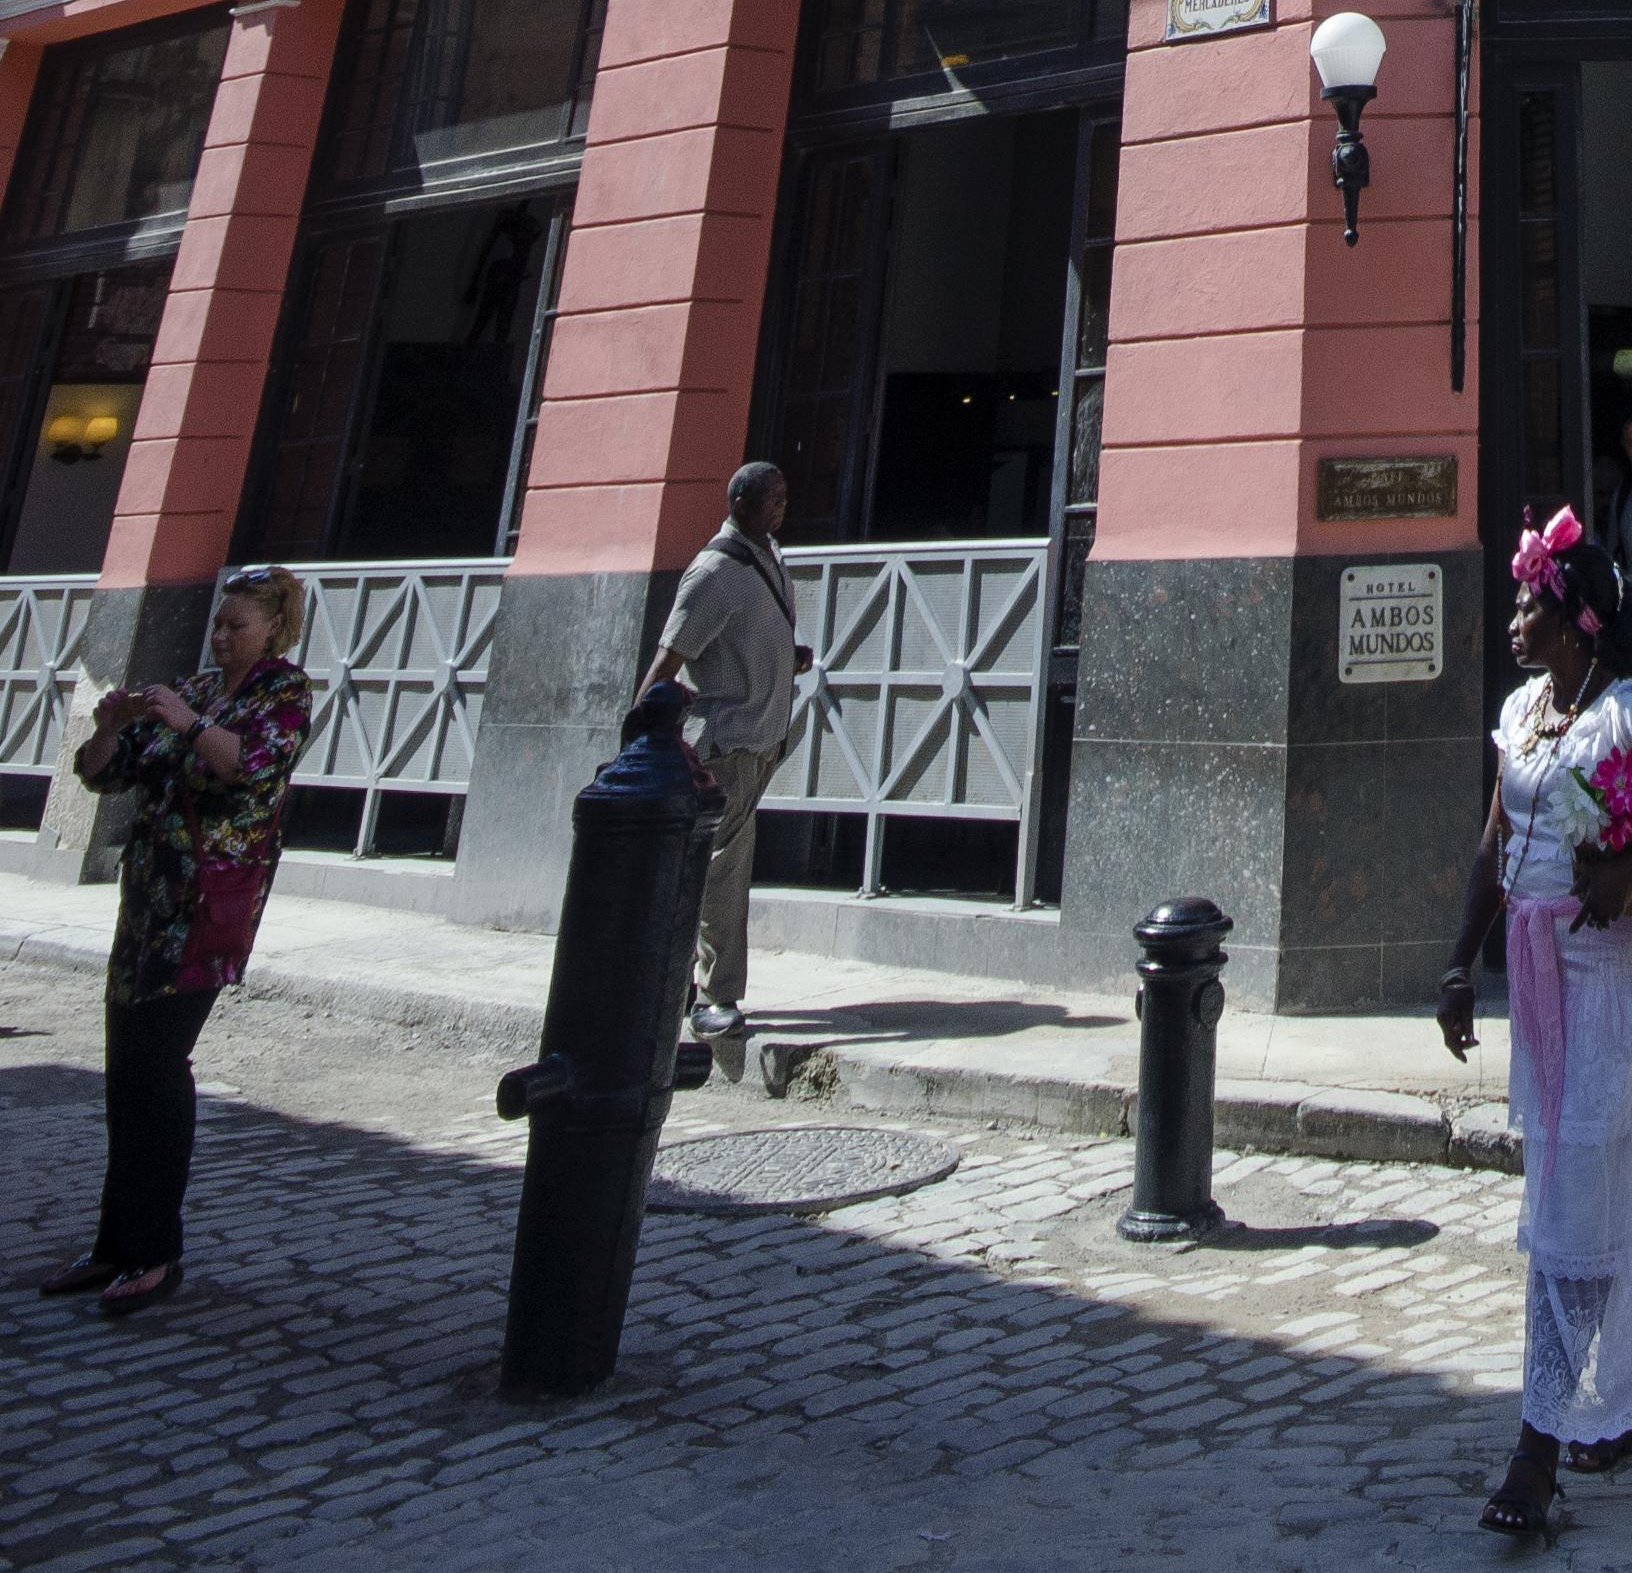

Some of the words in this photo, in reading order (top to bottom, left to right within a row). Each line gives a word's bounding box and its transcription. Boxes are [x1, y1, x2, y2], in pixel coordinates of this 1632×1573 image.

[1335, 493, 1379, 508] AMBOS
[1387, 492, 1442, 507] MUNDOS
[1366, 581, 1416, 594] HOTEL
[1351, 605, 1434, 628] AMBOS
[1349, 632, 1434, 656] MUNDOS
